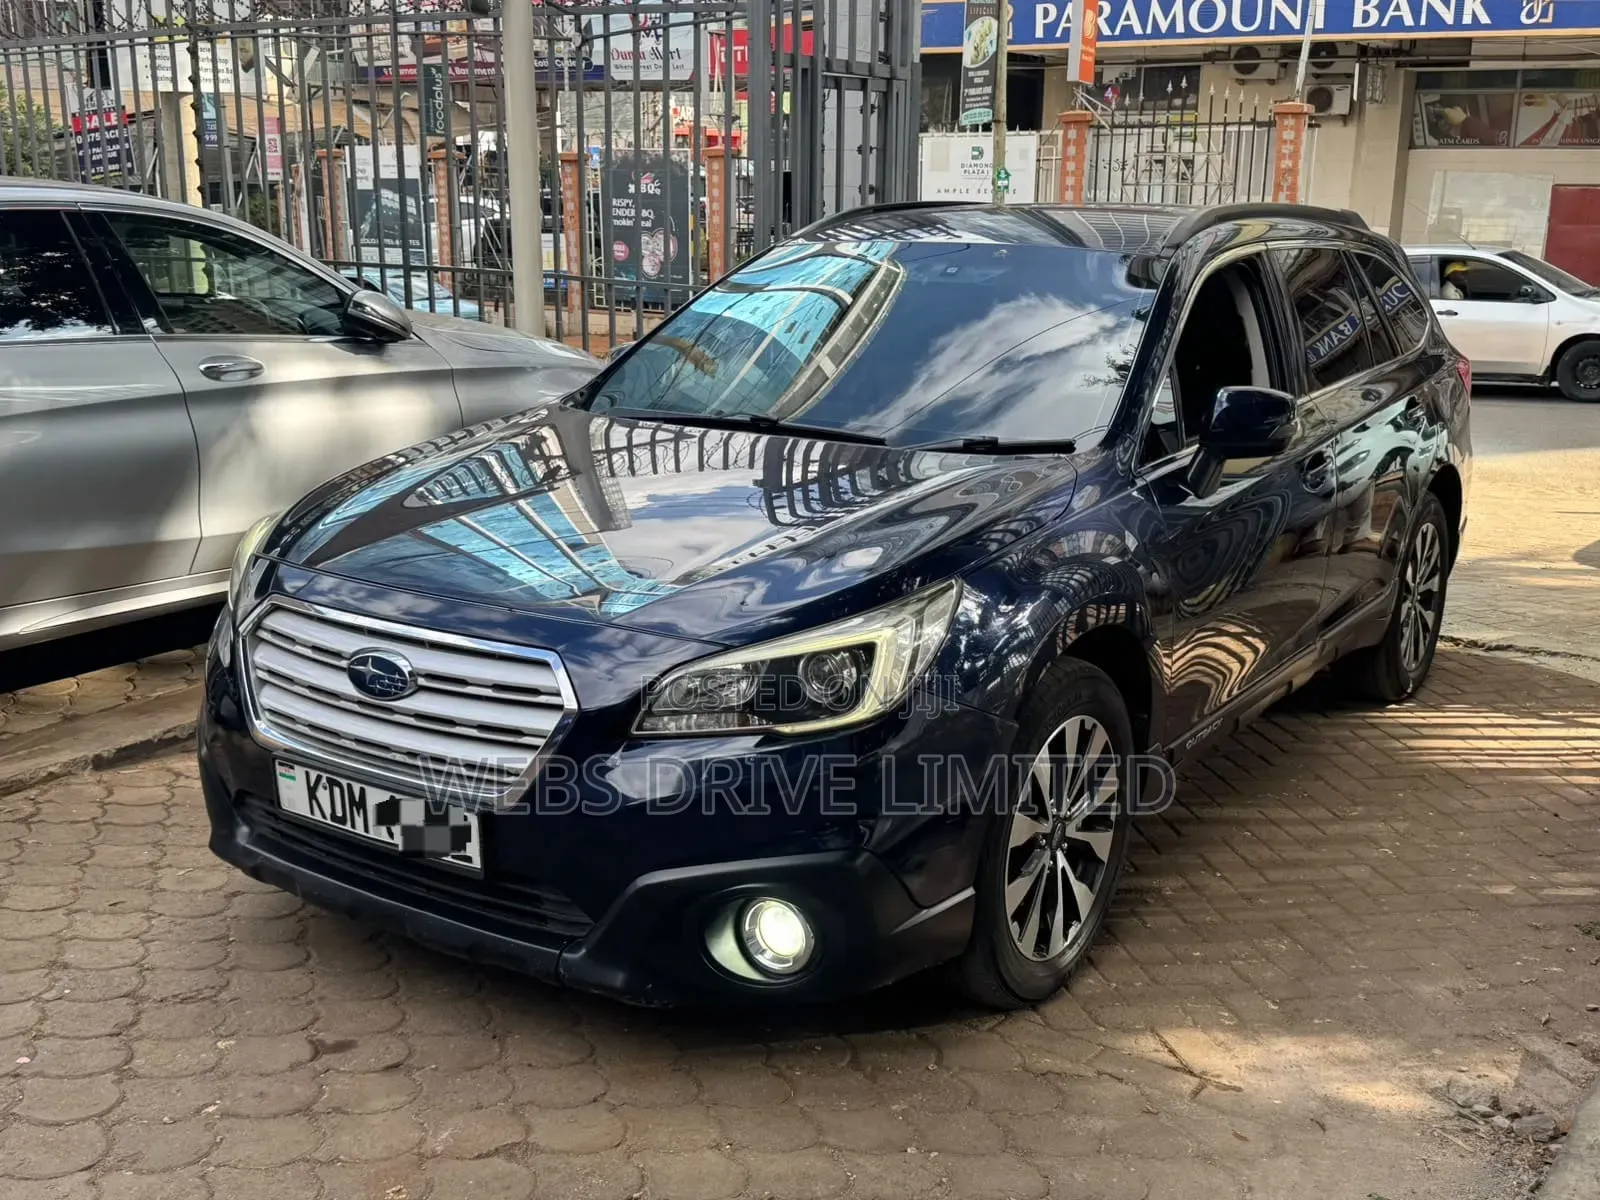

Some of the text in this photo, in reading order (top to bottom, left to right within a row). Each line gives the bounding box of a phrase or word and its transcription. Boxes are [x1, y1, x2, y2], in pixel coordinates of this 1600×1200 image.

[1352, 0, 1492, 28] BANK
[104, 128, 128, 139] ACE
[612, 198, 635, 208] RISPY,
[612, 208, 635, 217] ENDE
[304, 769, 370, 835] KDM
